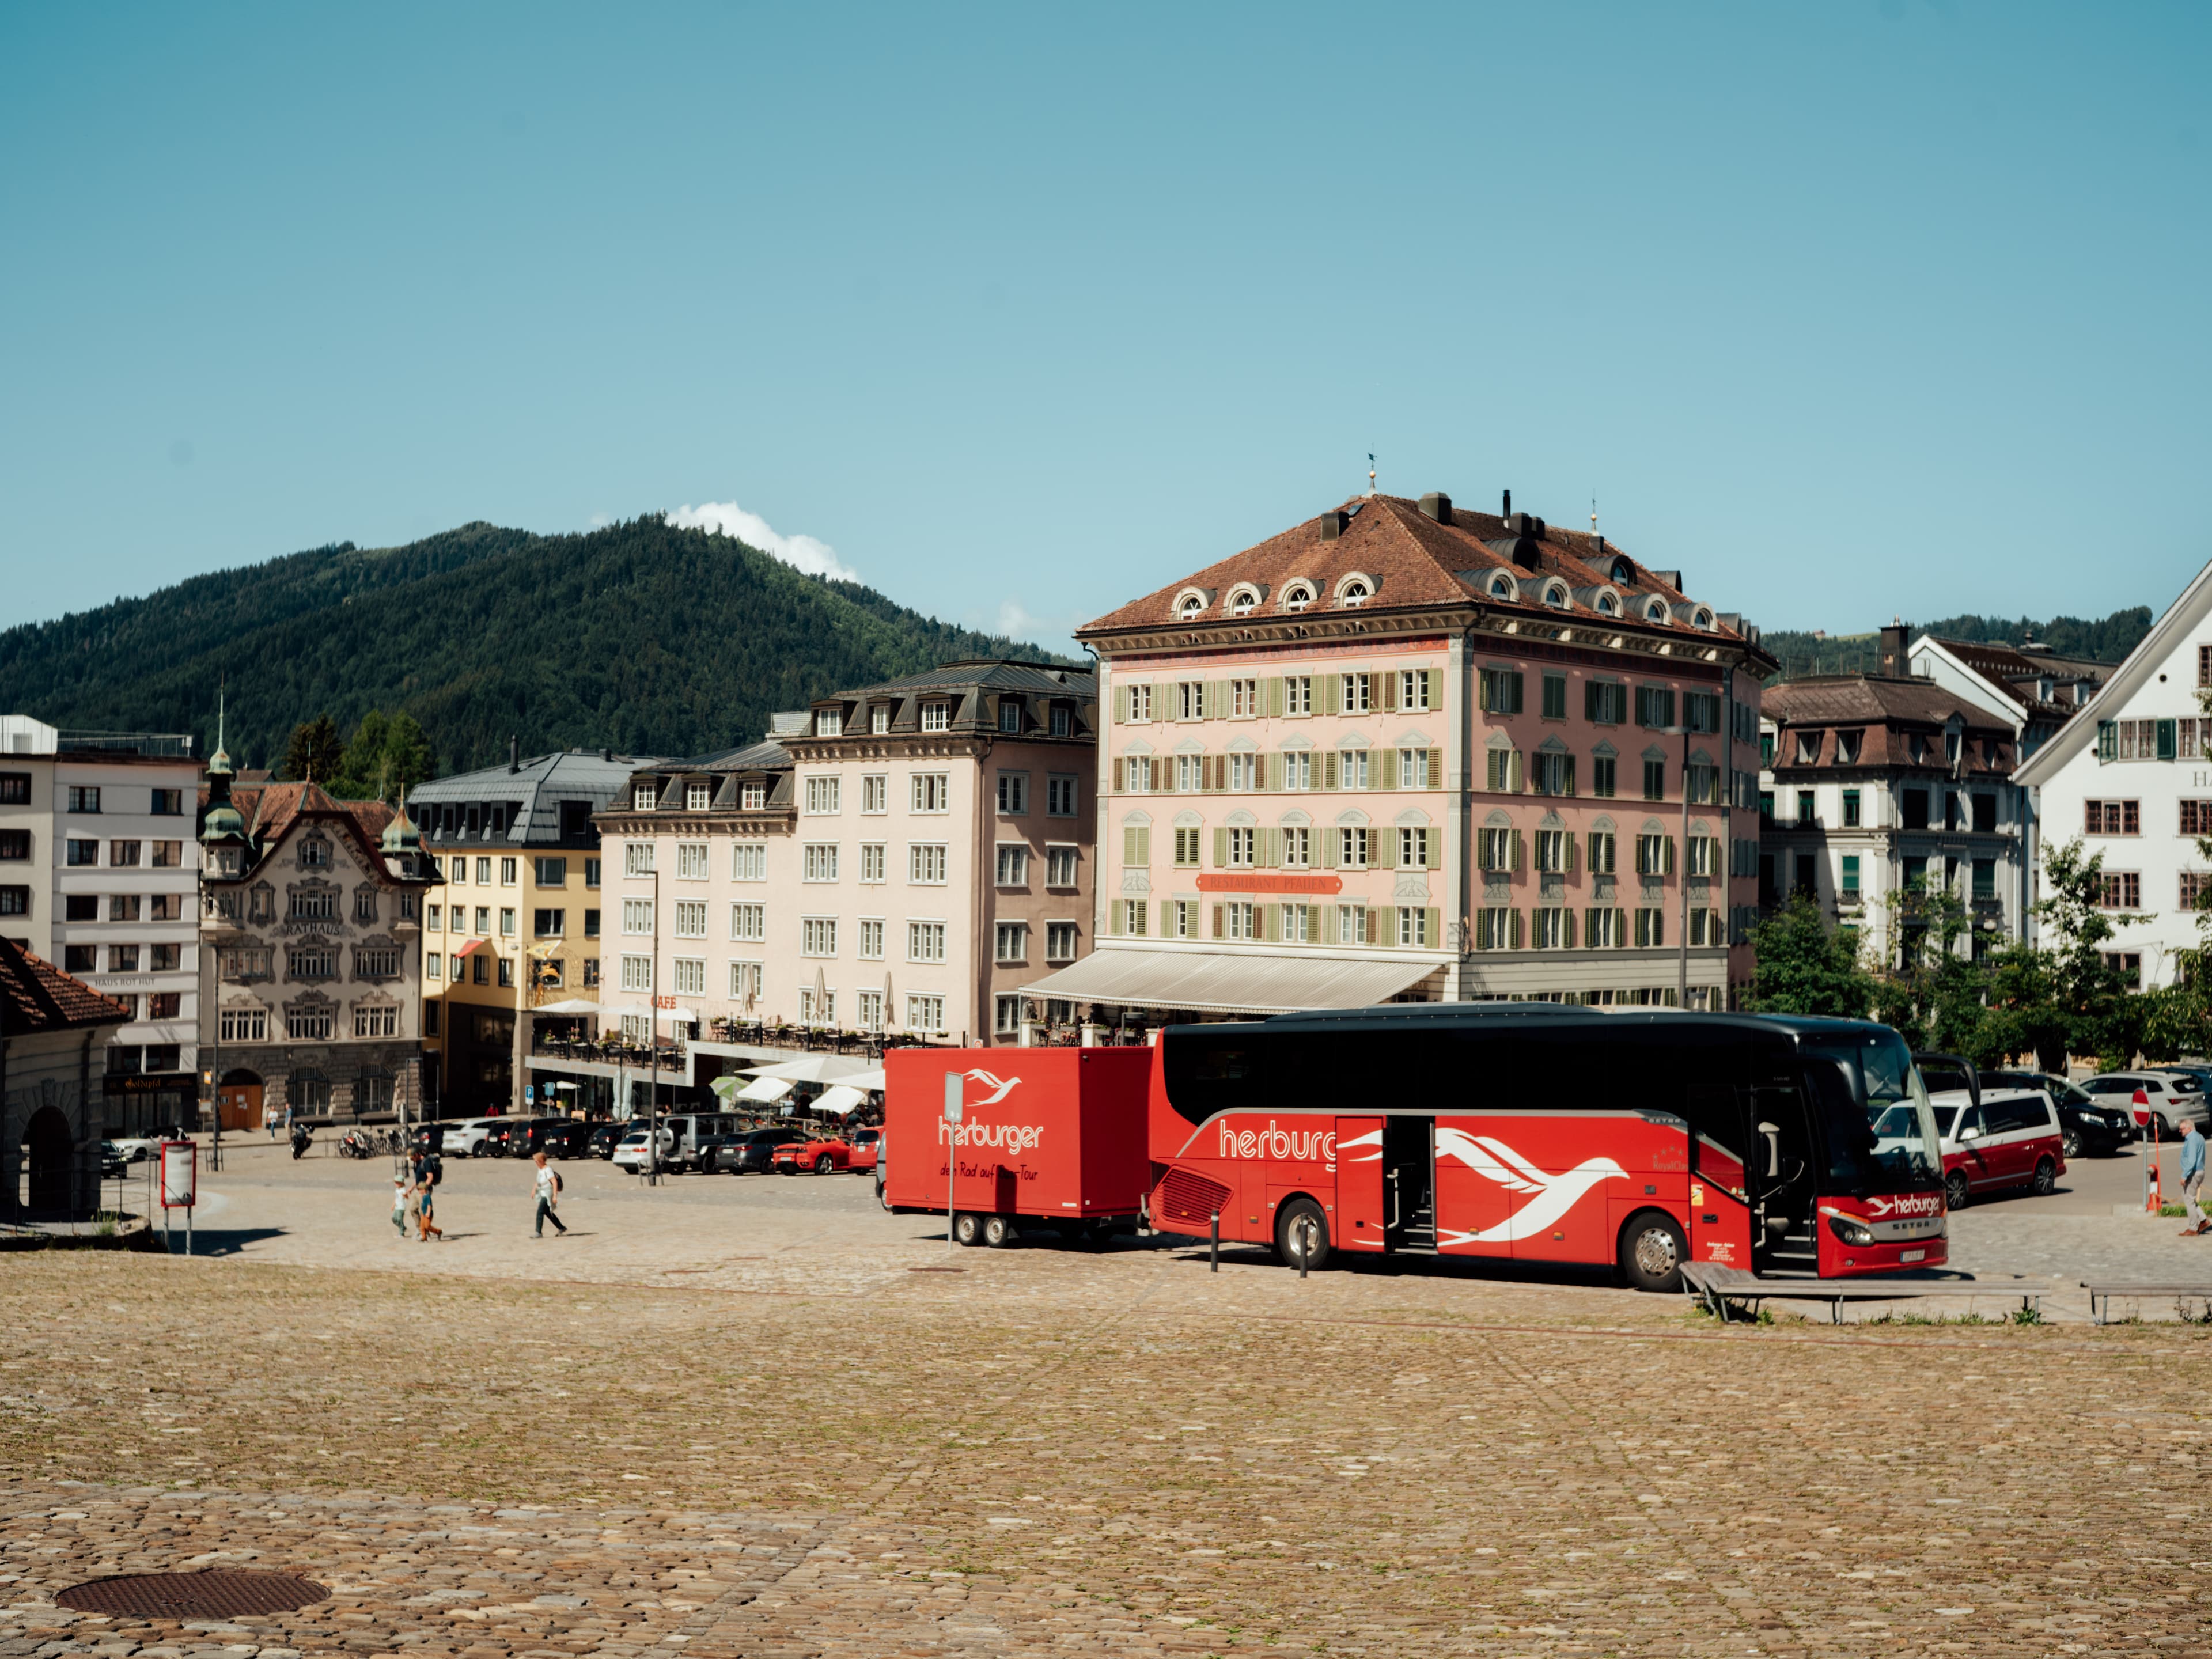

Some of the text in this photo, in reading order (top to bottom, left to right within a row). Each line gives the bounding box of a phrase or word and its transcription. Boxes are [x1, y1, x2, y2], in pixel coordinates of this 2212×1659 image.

[1210, 876, 1327, 890] RESTAURANT PFAUEN
[286, 922, 340, 936] RATHAUS
[95, 977, 155, 987] HAUS ROT HUT
[528, 1088, 532, 1097] P
[938, 1115, 1044, 1155] herburger
[960, 1162, 978, 1177] Rad
[980, 1164, 995, 1185] auf
[1894, 1194, 1940, 1216] herburger
[1893, 1221, 1929, 1229] SETRA
